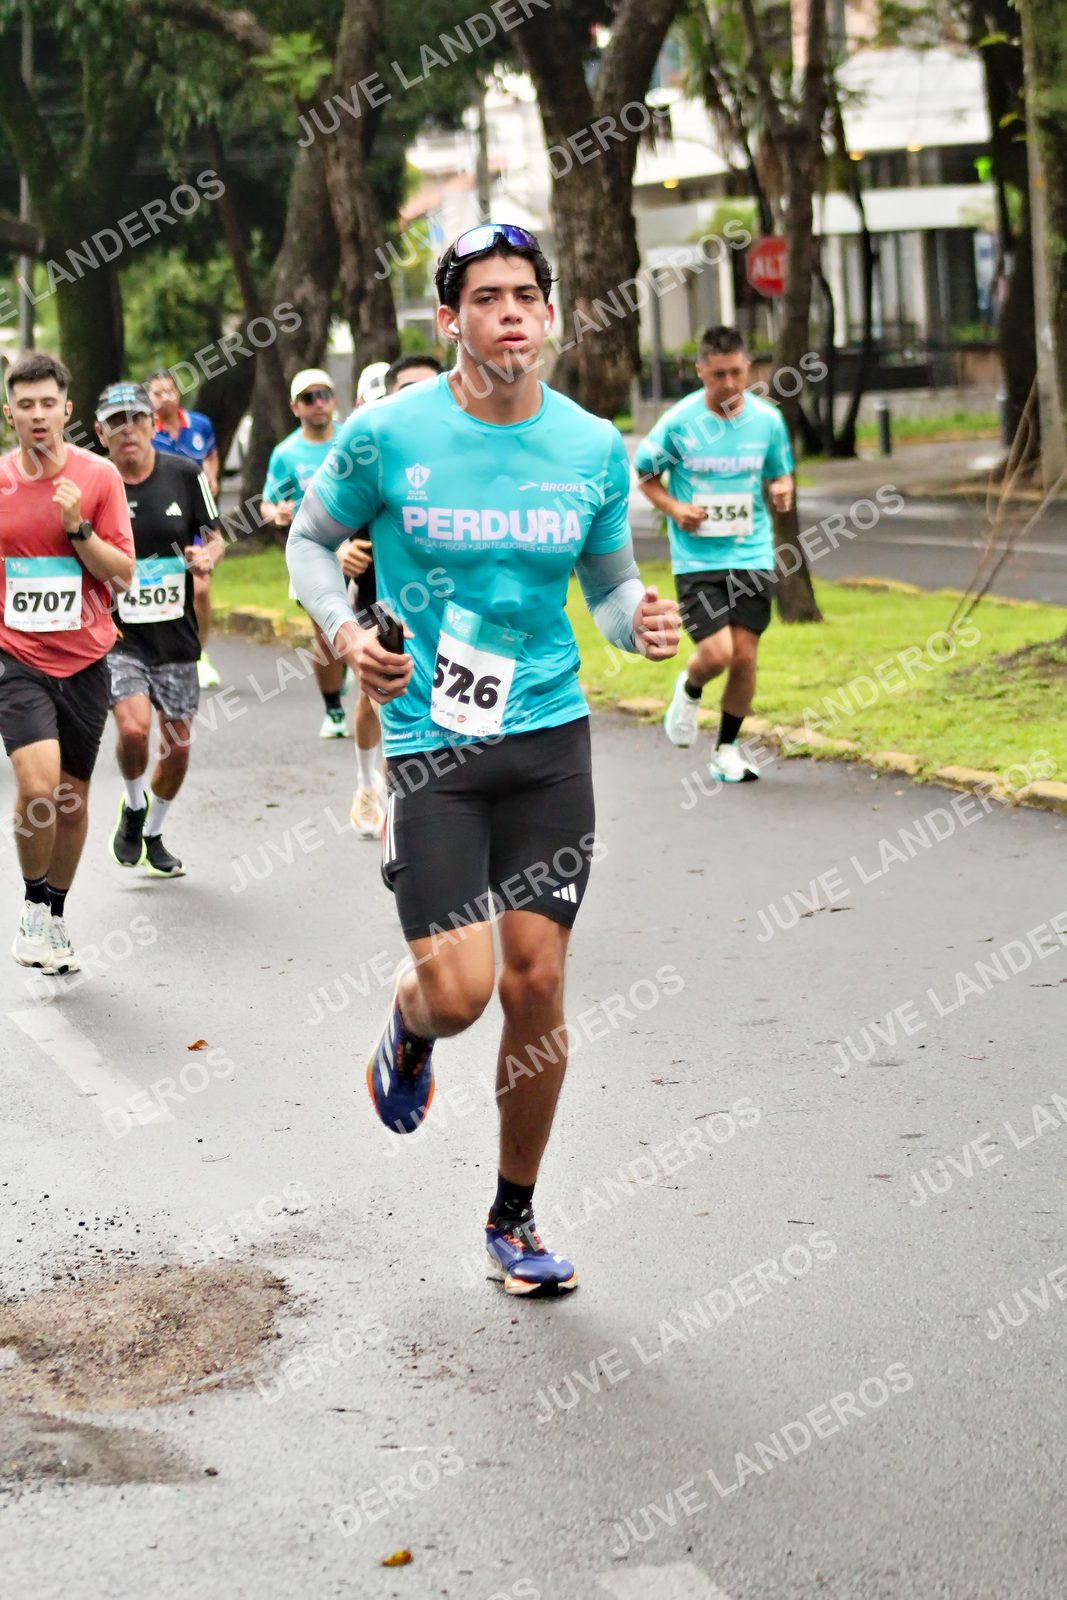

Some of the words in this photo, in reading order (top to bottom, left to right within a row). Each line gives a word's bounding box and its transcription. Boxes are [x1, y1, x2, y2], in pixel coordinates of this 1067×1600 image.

[541, 482, 587, 493] BROOKS
[402, 506, 582, 544] PERDURA
[12, 591, 77, 613] 6707
[123, 587, 180, 607] 4503
